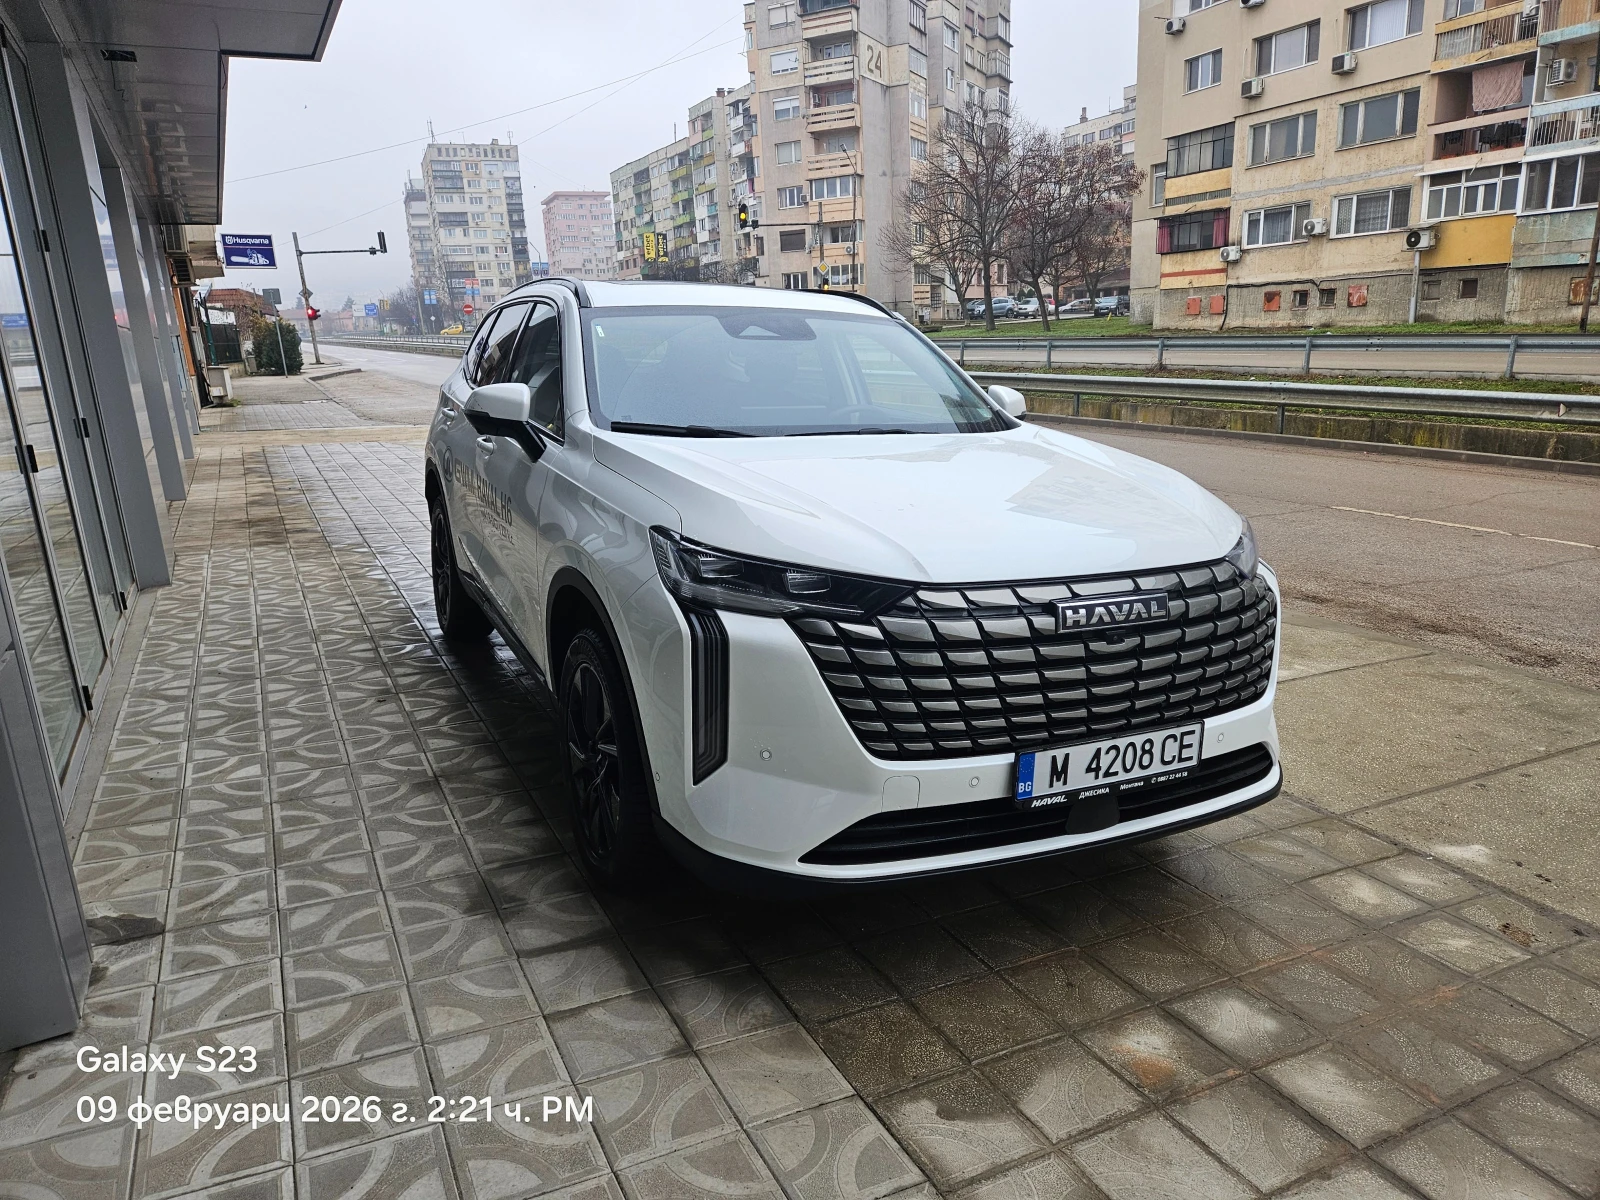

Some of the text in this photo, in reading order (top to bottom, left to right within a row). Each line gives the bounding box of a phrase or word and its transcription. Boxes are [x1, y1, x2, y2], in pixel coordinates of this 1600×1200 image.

[866, 44, 882, 78] 24
[233, 236, 269, 245] Husqvarna
[500, 491, 513, 527] H6
[1065, 601, 1166, 627] HAVAL
[1048, 730, 1196, 788] M 4208 CE
[1018, 781, 1032, 793] BG
[1031, 795, 1068, 808] HAVAL
[1078, 787, 1110, 800] ДЖЕСИКА
